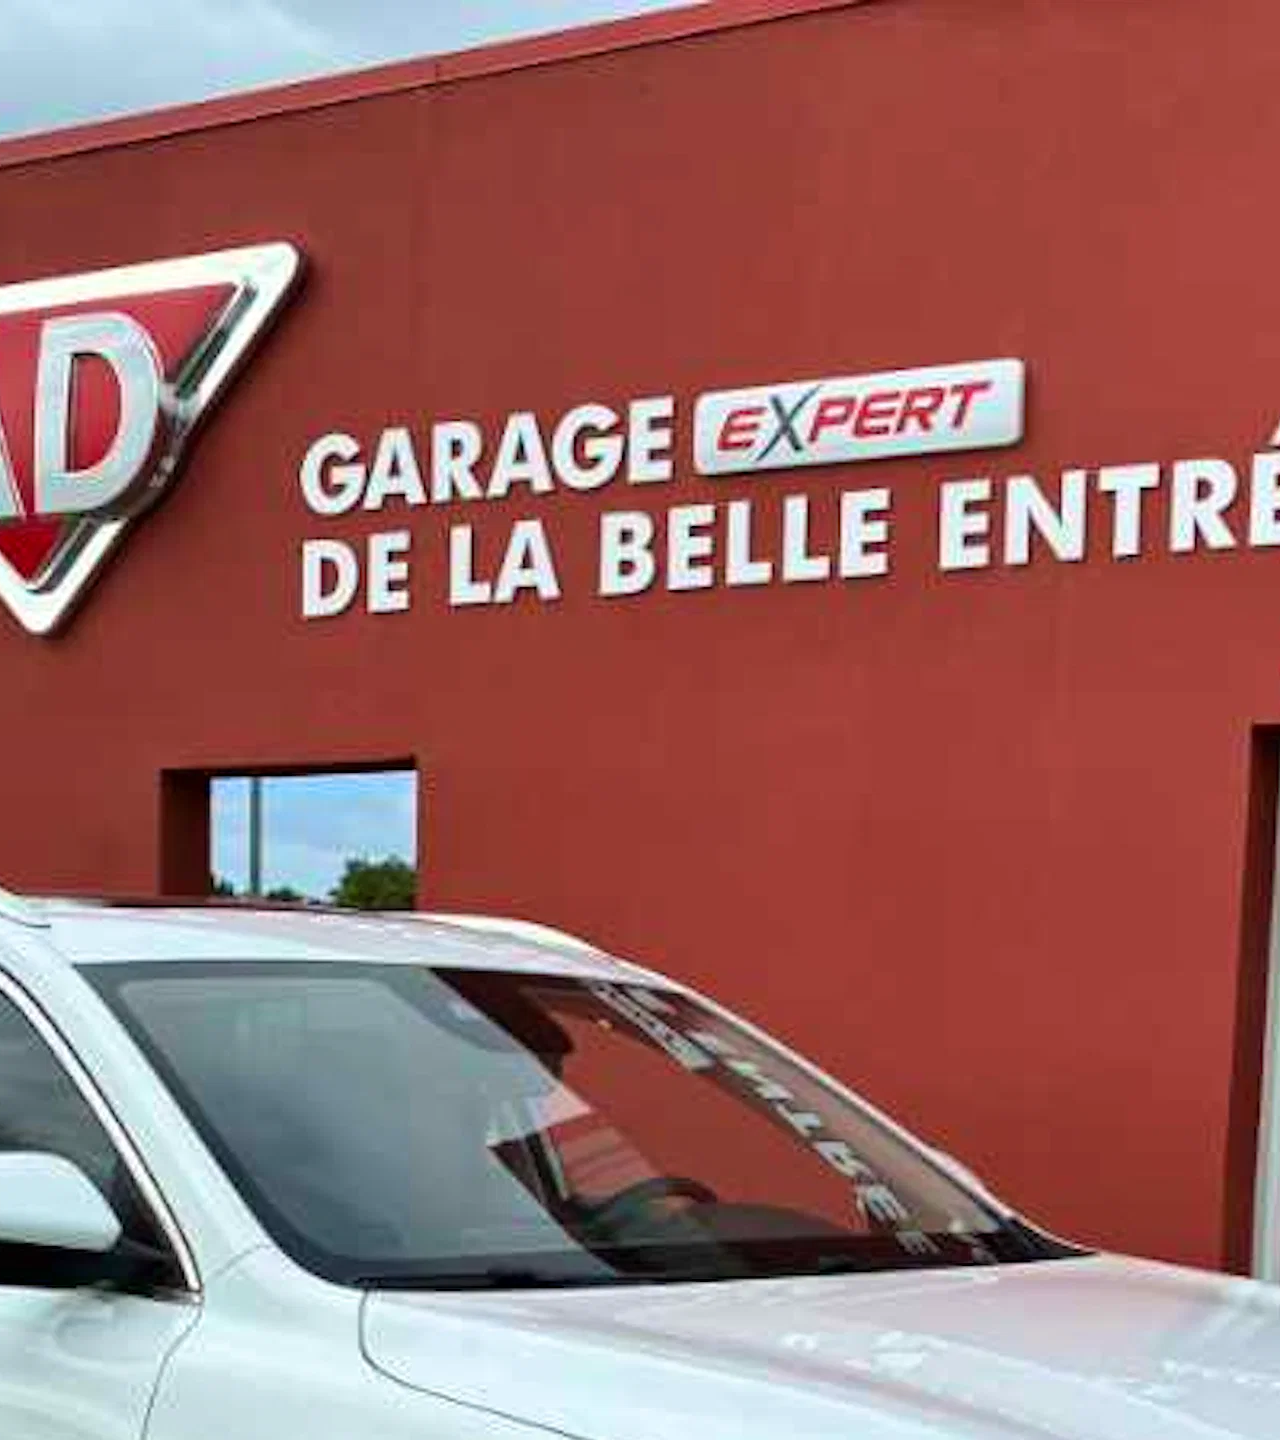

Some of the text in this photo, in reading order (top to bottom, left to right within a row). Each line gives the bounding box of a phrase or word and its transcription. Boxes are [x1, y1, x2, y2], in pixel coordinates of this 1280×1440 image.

[299, 395, 675, 516] GARAGE
[716, 380, 993, 461] EXPERT
[301, 530, 412, 618] DE
[448, 519, 561, 606] LA
[598, 488, 891, 597] BELLE
